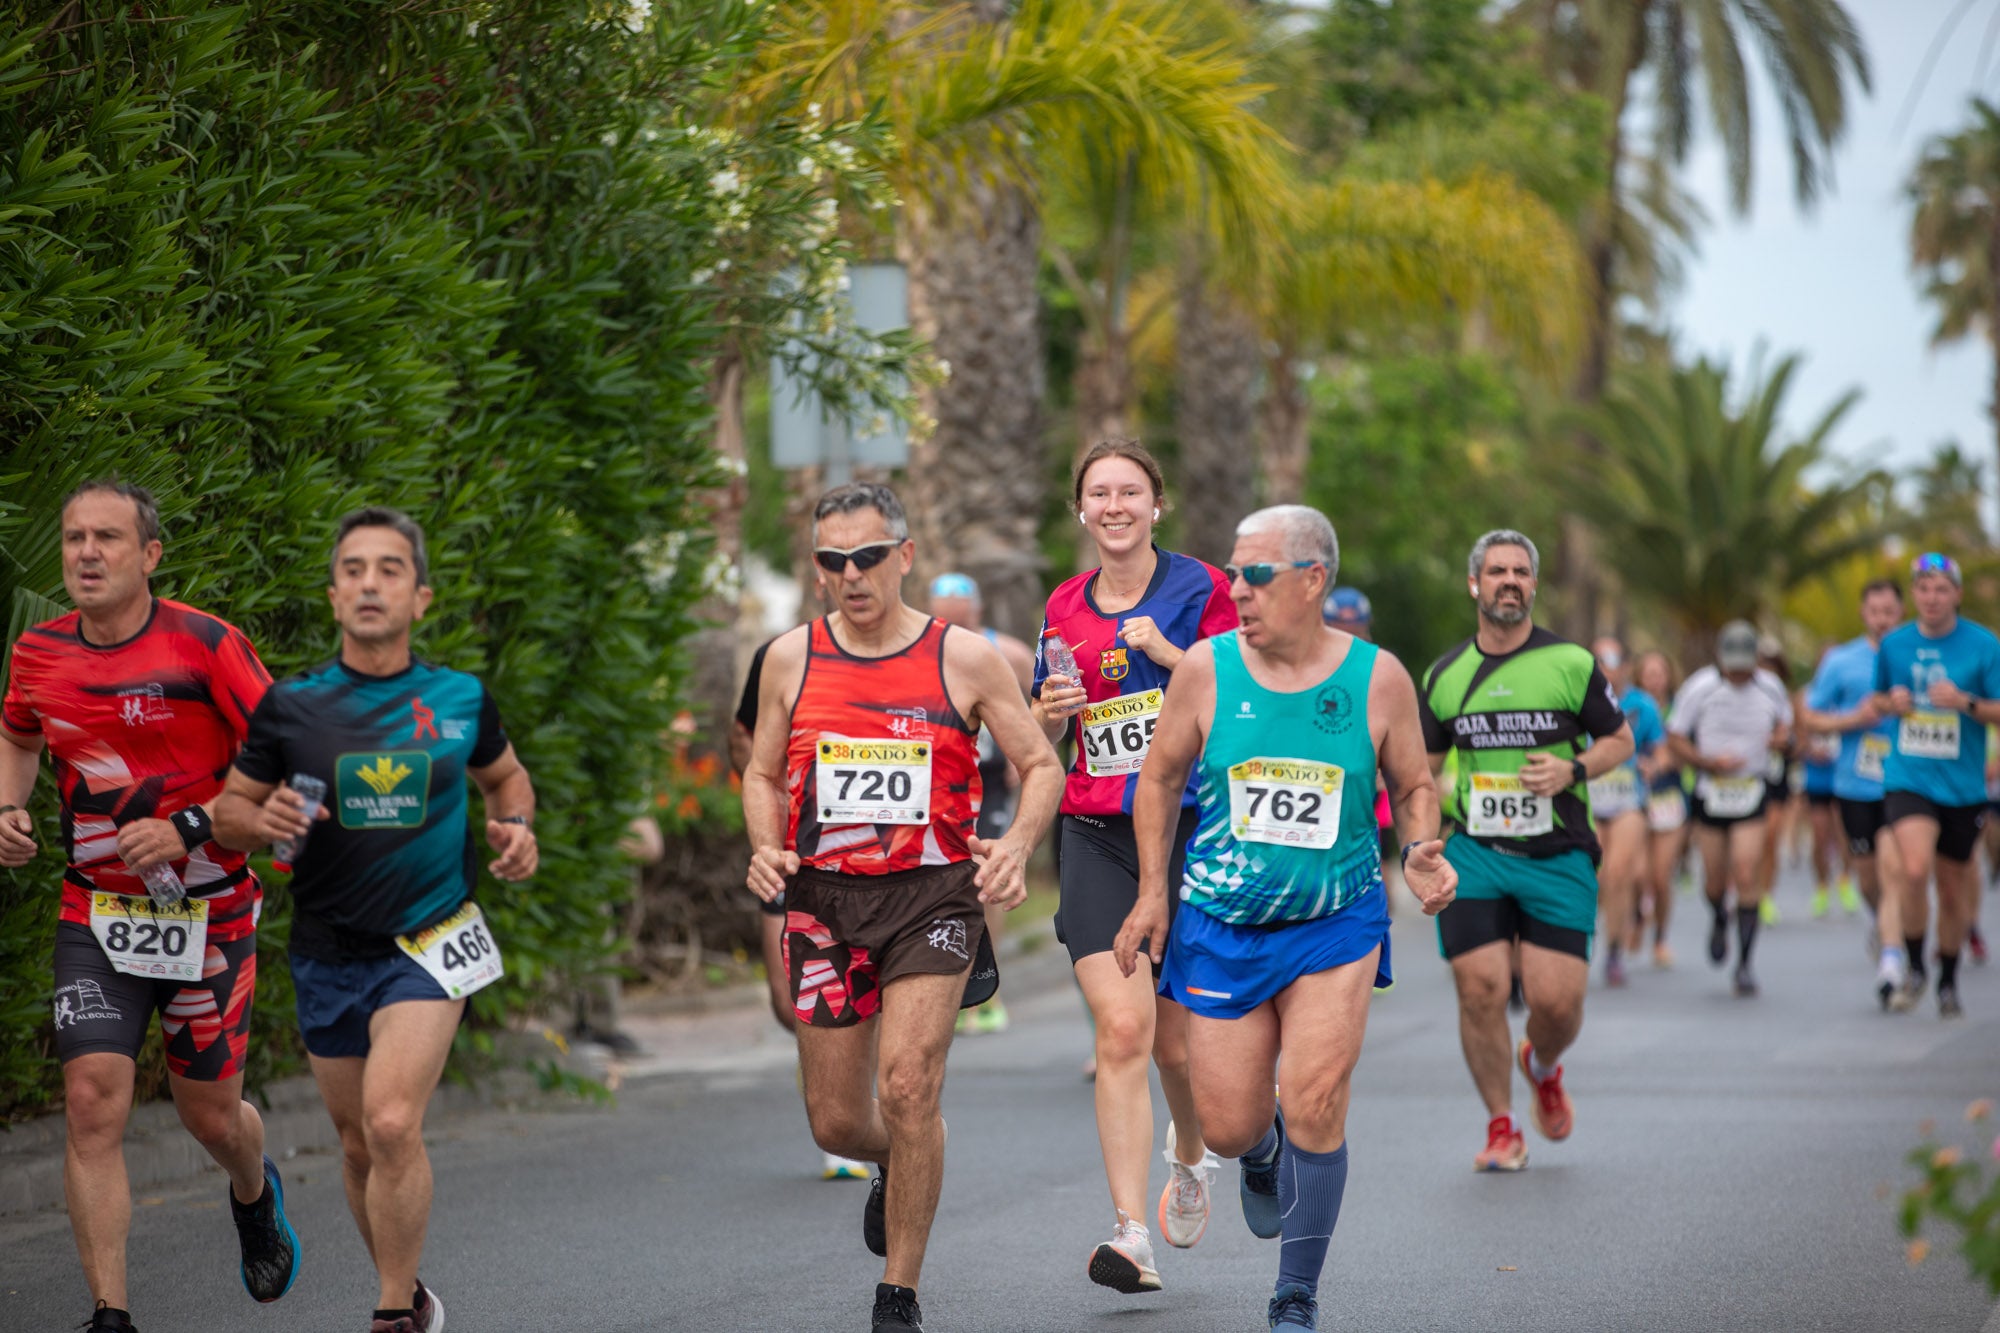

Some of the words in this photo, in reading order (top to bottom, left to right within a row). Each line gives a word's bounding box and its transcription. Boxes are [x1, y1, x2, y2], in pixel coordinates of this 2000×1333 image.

[1093, 701, 1144, 721] FONDO
[1113, 697, 1137, 707] PREMIO
[1455, 714, 1491, 736] CAJA
[1495, 712, 1559, 732] RURAL
[1084, 718, 1158, 758] 3165
[1471, 732, 1538, 748] GRANADA
[833, 744, 850, 759] 38
[850, 749, 907, 761] FONDO
[1263, 766, 1320, 782] FONDO
[834, 770, 912, 802] 720
[1246, 786, 1322, 825] 762
[1482, 796, 1538, 819] 965
[1075, 814, 1099, 826] CRAFT
[106, 921, 188, 957] 820
[443, 924, 491, 971] 466
[76, 1012, 123, 1021] ALBOLOTE
